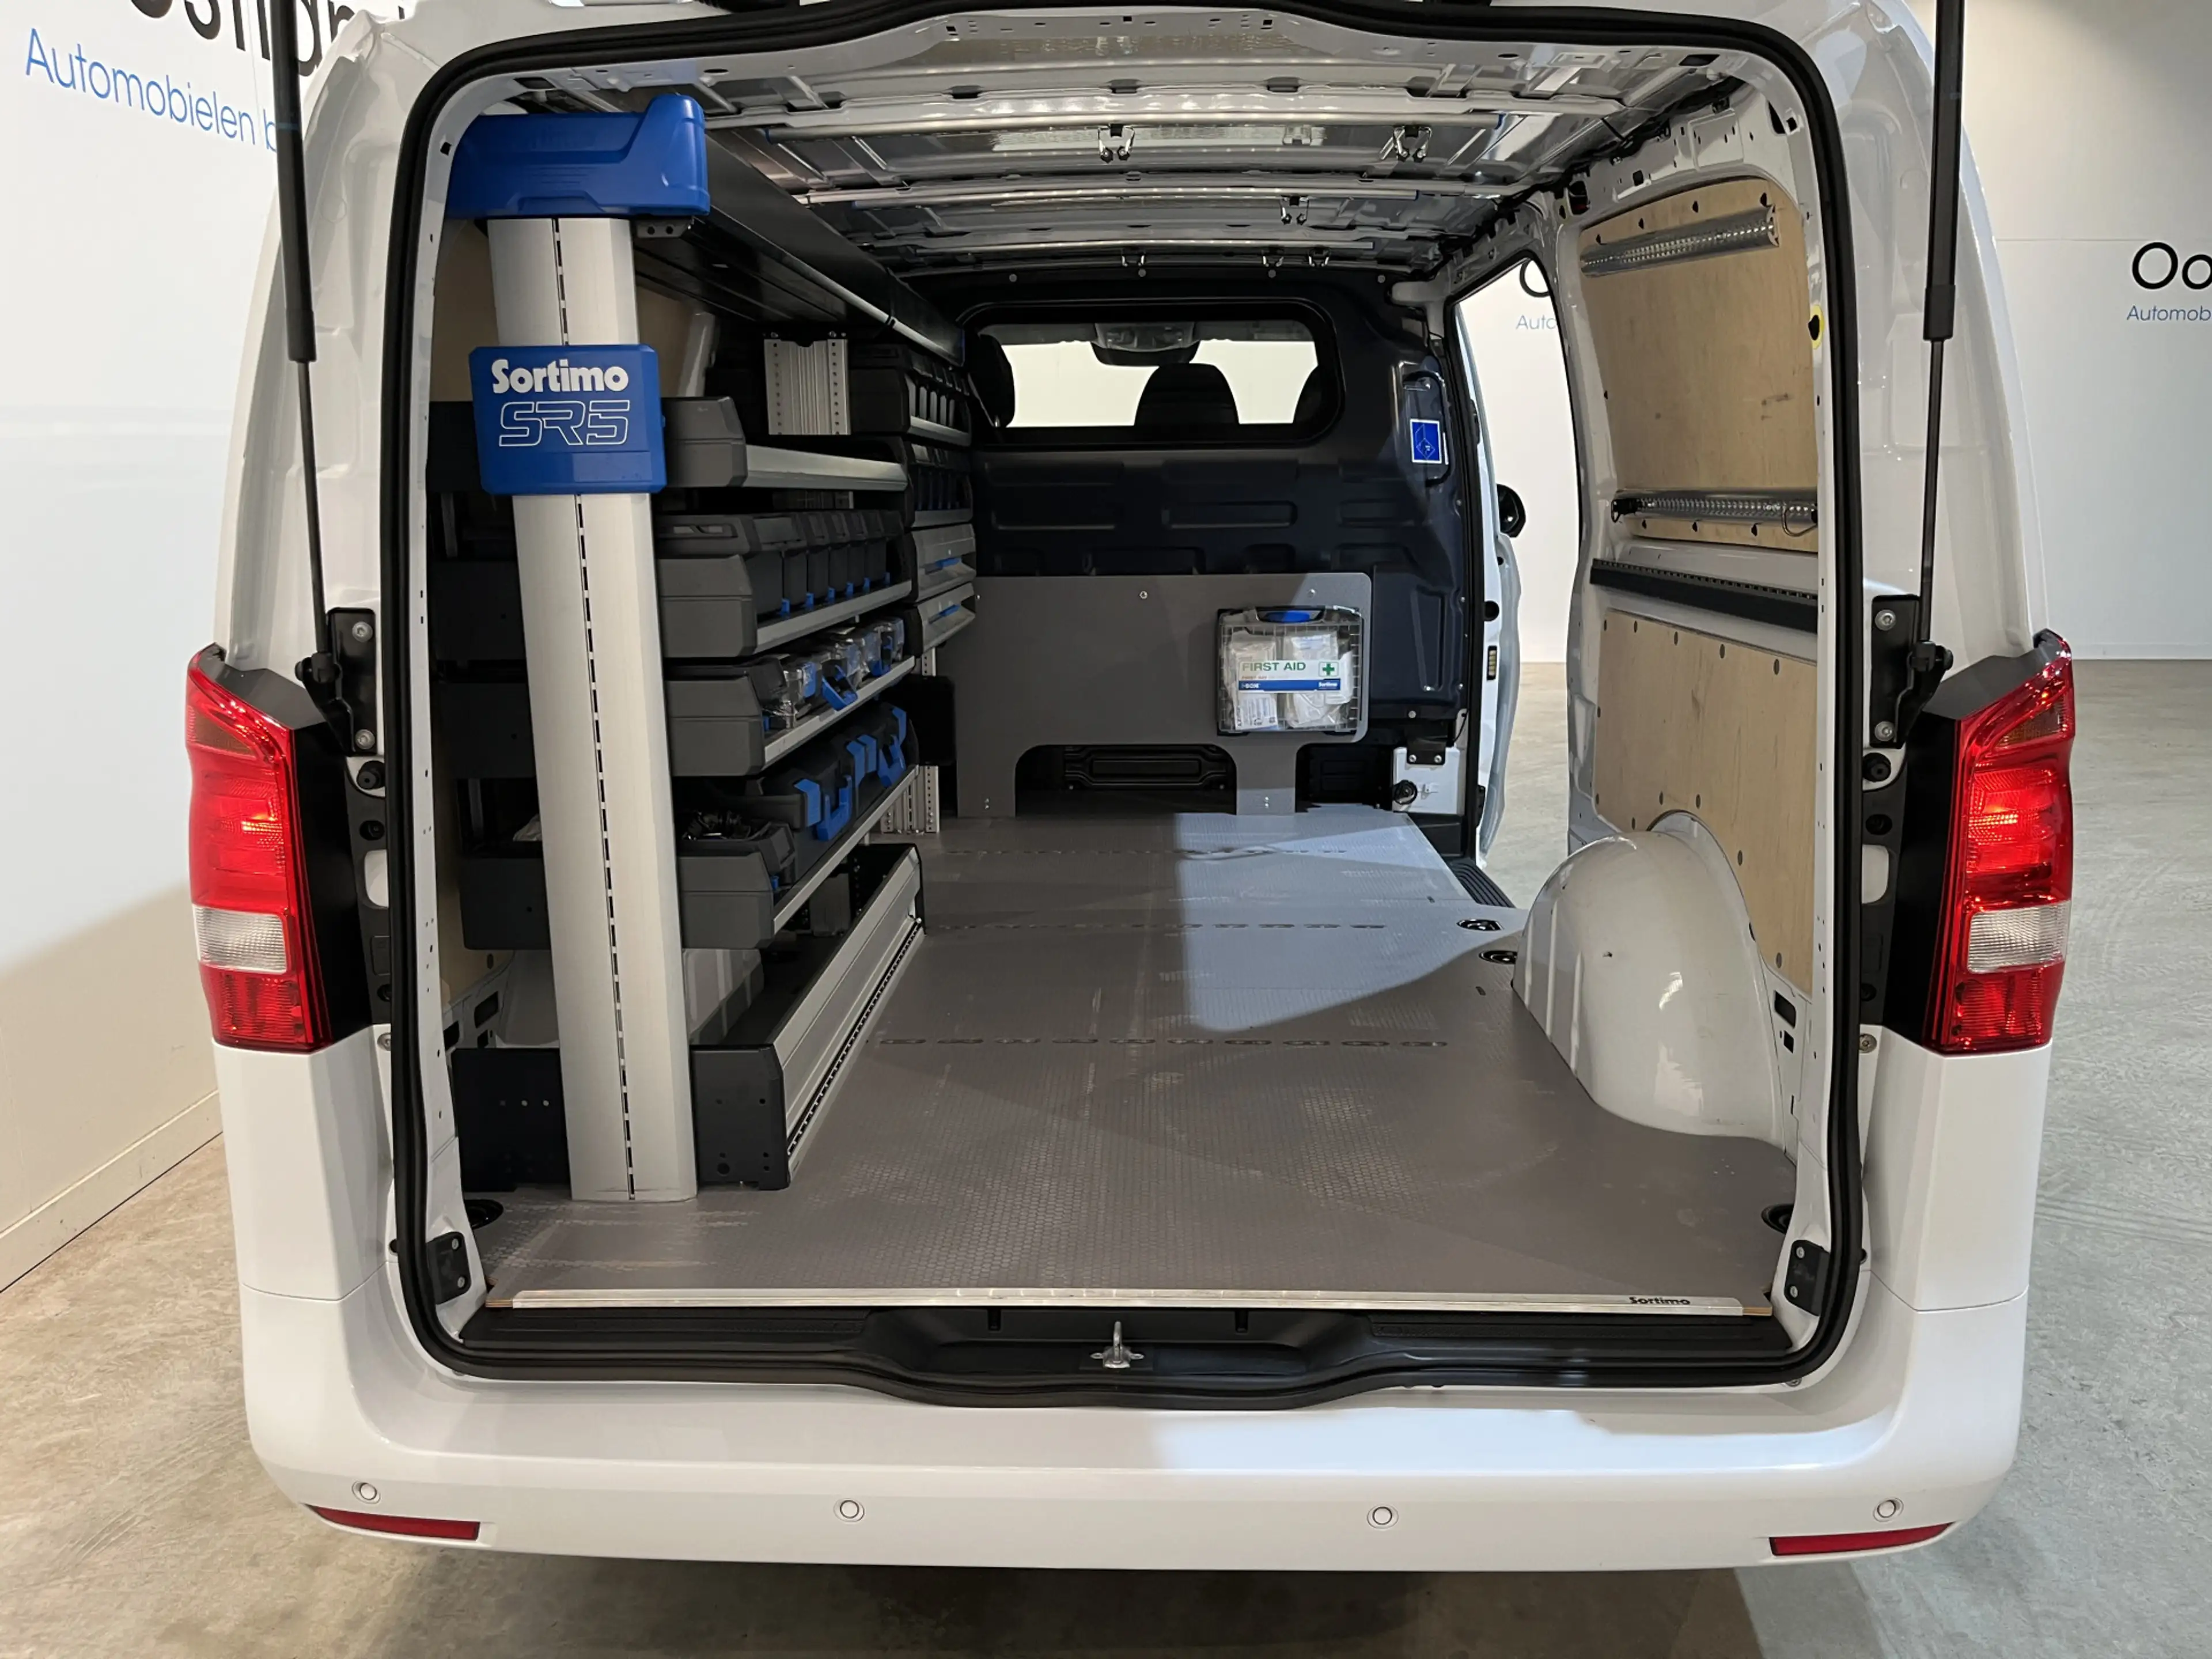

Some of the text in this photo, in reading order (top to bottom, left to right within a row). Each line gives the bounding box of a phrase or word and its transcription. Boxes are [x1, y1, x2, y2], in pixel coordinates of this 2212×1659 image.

[26, 28, 255, 145] Automobielen
[2132, 242, 2212, 290] Oo
[2127, 305, 2211, 321] Automob
[491, 359, 629, 393] Sortimo
[499, 400, 630, 446] SR5
[1243, 662, 1306, 672] FIRST AID
[1629, 1297, 1691, 1305] Sortimo
